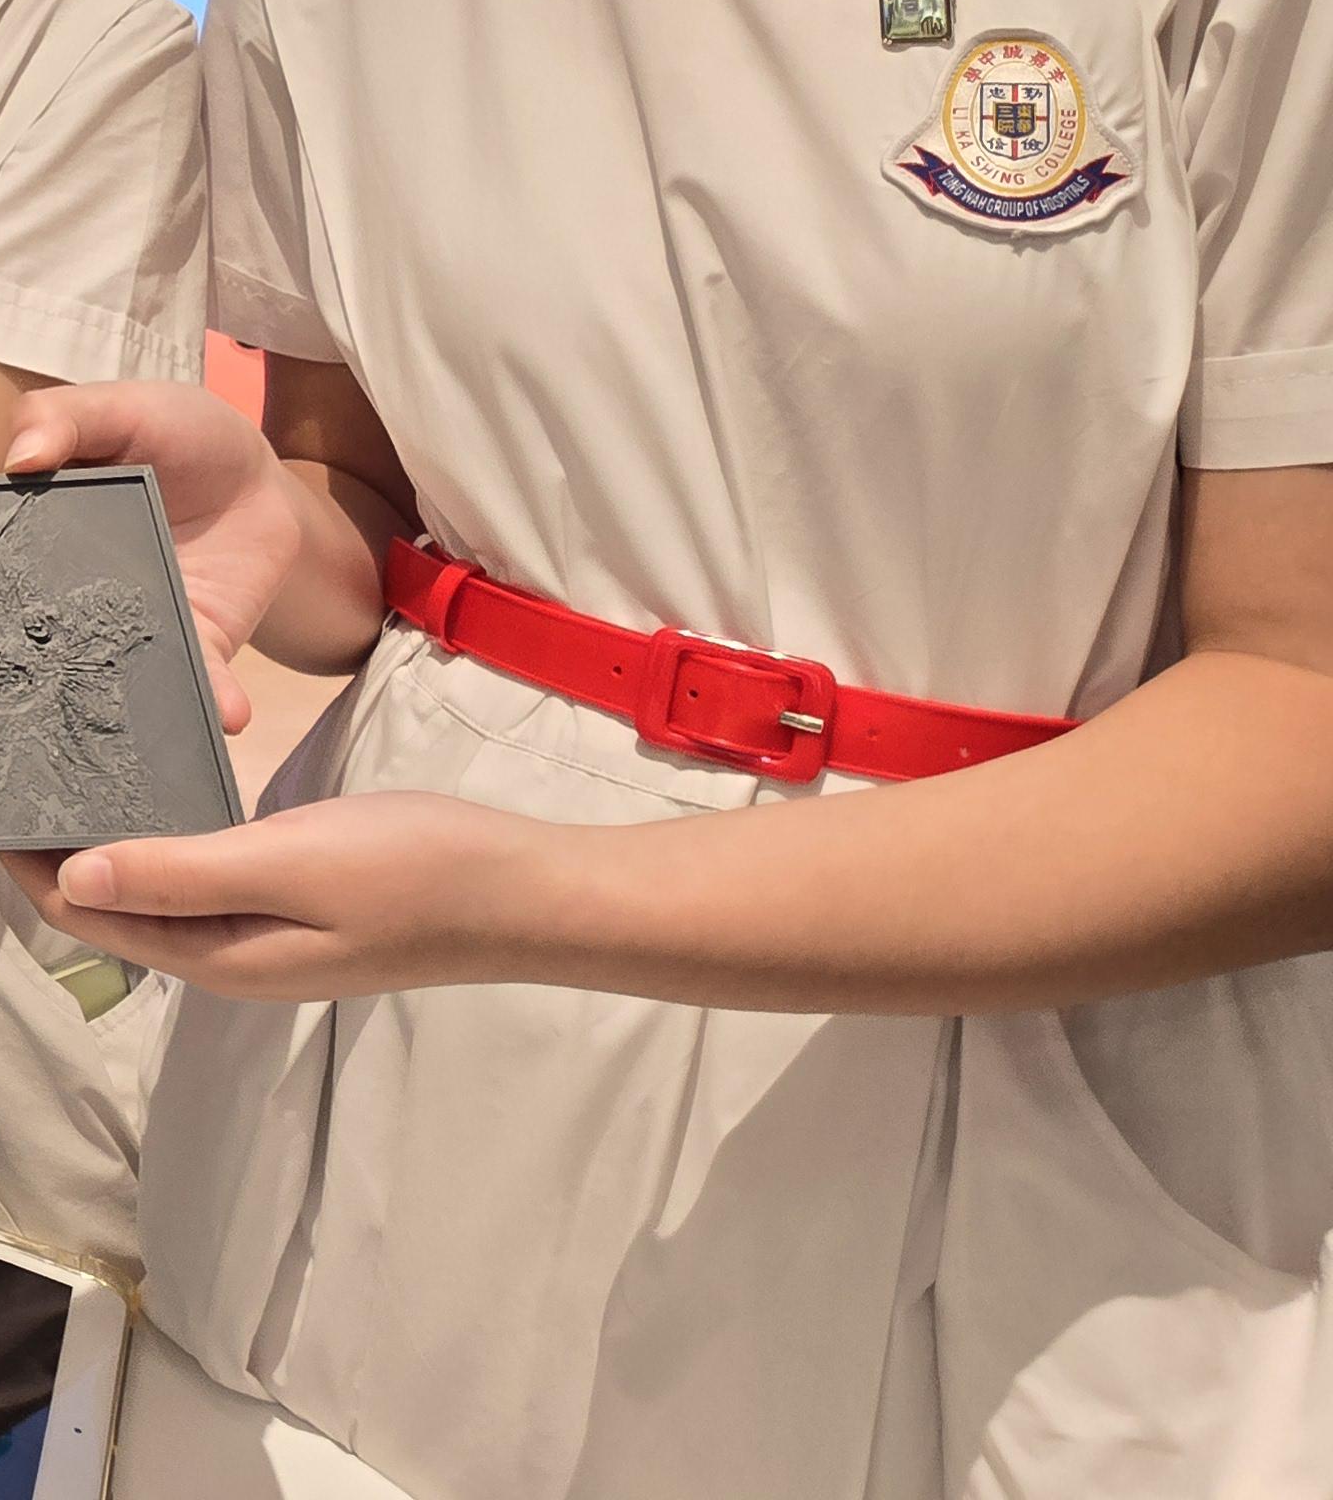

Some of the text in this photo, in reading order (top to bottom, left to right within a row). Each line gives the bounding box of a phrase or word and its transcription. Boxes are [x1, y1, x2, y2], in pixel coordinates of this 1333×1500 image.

[953, 107, 968, 121] LI
[956, 130, 974, 150] KA
[1035, 109, 1077, 178] COLLEGE
[970, 155, 1025, 185] SHING
[939, 170, 1090, 217] TUNG WAH GROUP OF HOSPITALS
